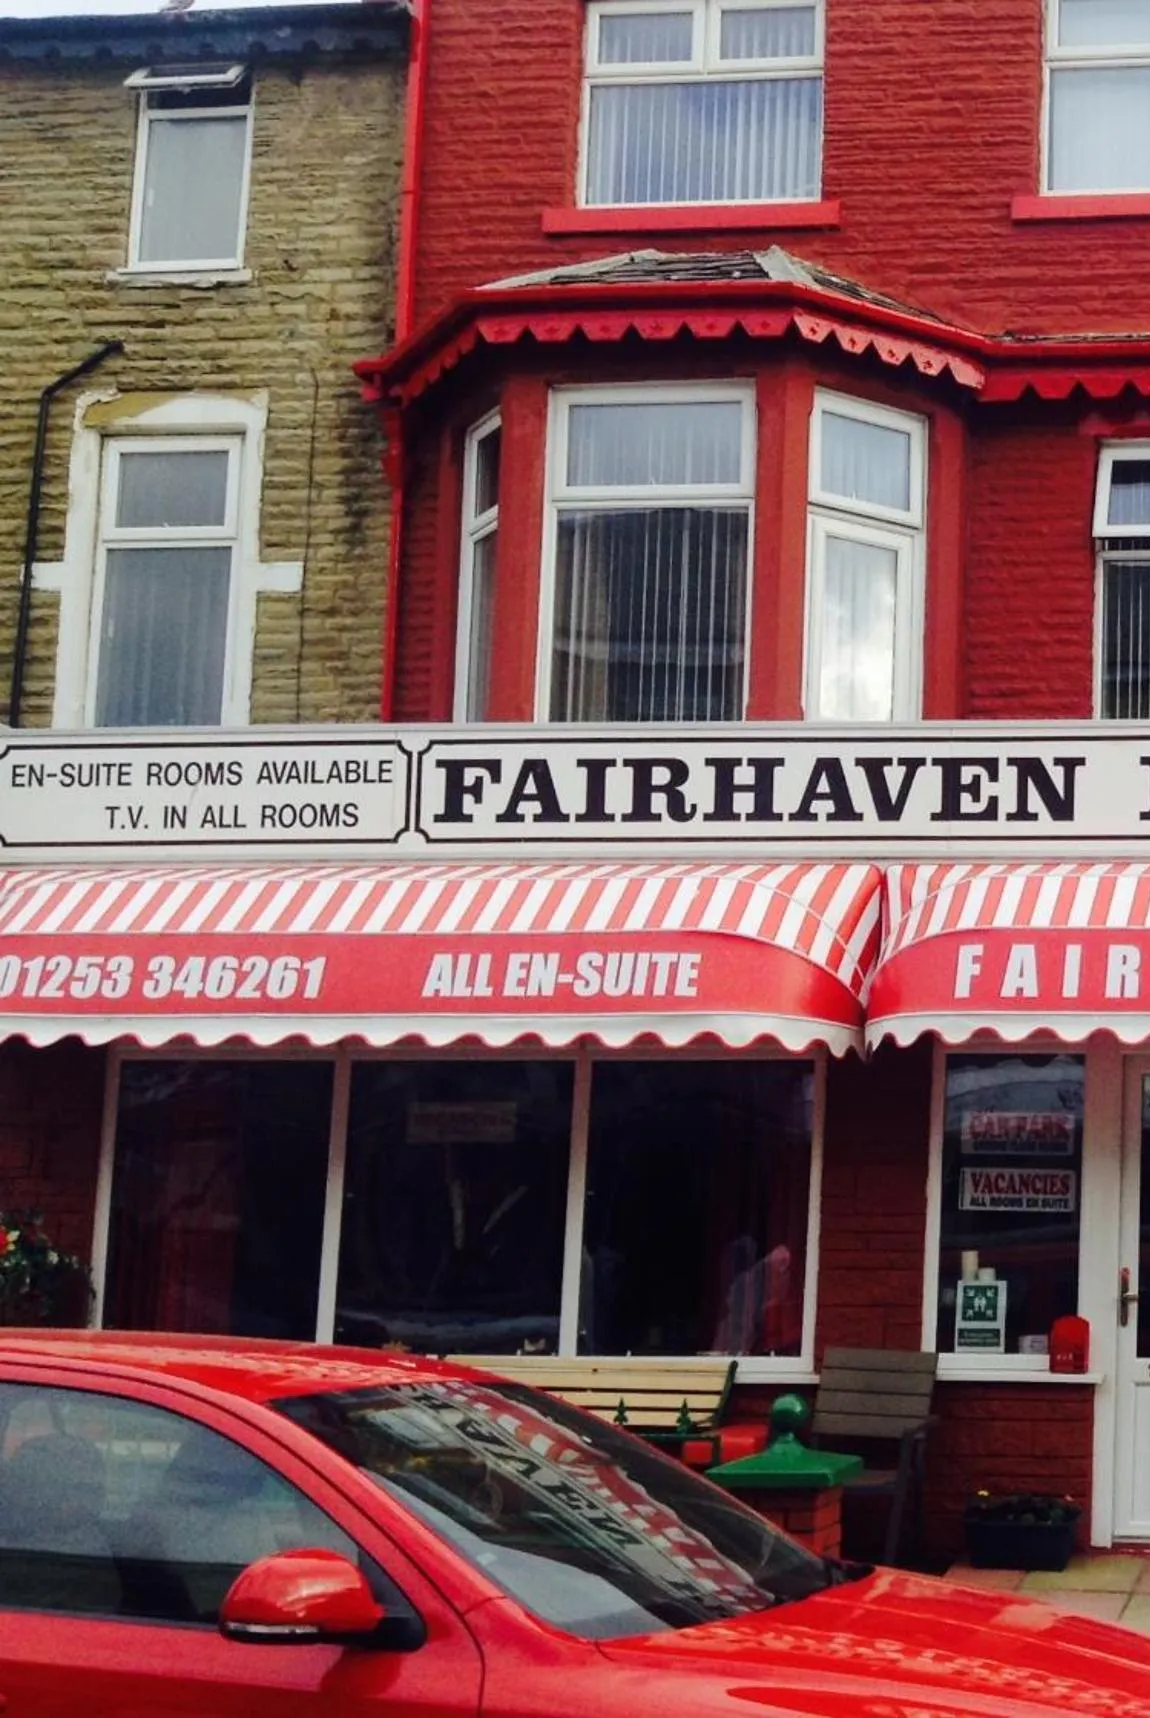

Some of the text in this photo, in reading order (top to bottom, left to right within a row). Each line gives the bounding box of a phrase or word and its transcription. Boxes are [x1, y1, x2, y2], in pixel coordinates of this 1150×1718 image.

[10, 759, 394, 788] EN-SUITE ROOMS AVAILABLE
[433, 757, 1086, 824] FAIRHAVEN
[104, 802, 359, 830] T.V. IN ALL ROOMS
[0, 955, 326, 999] 01253 346261
[421, 951, 702, 998] ALL EN-SUITE
[969, 1171, 1071, 1197] VACANCIES
